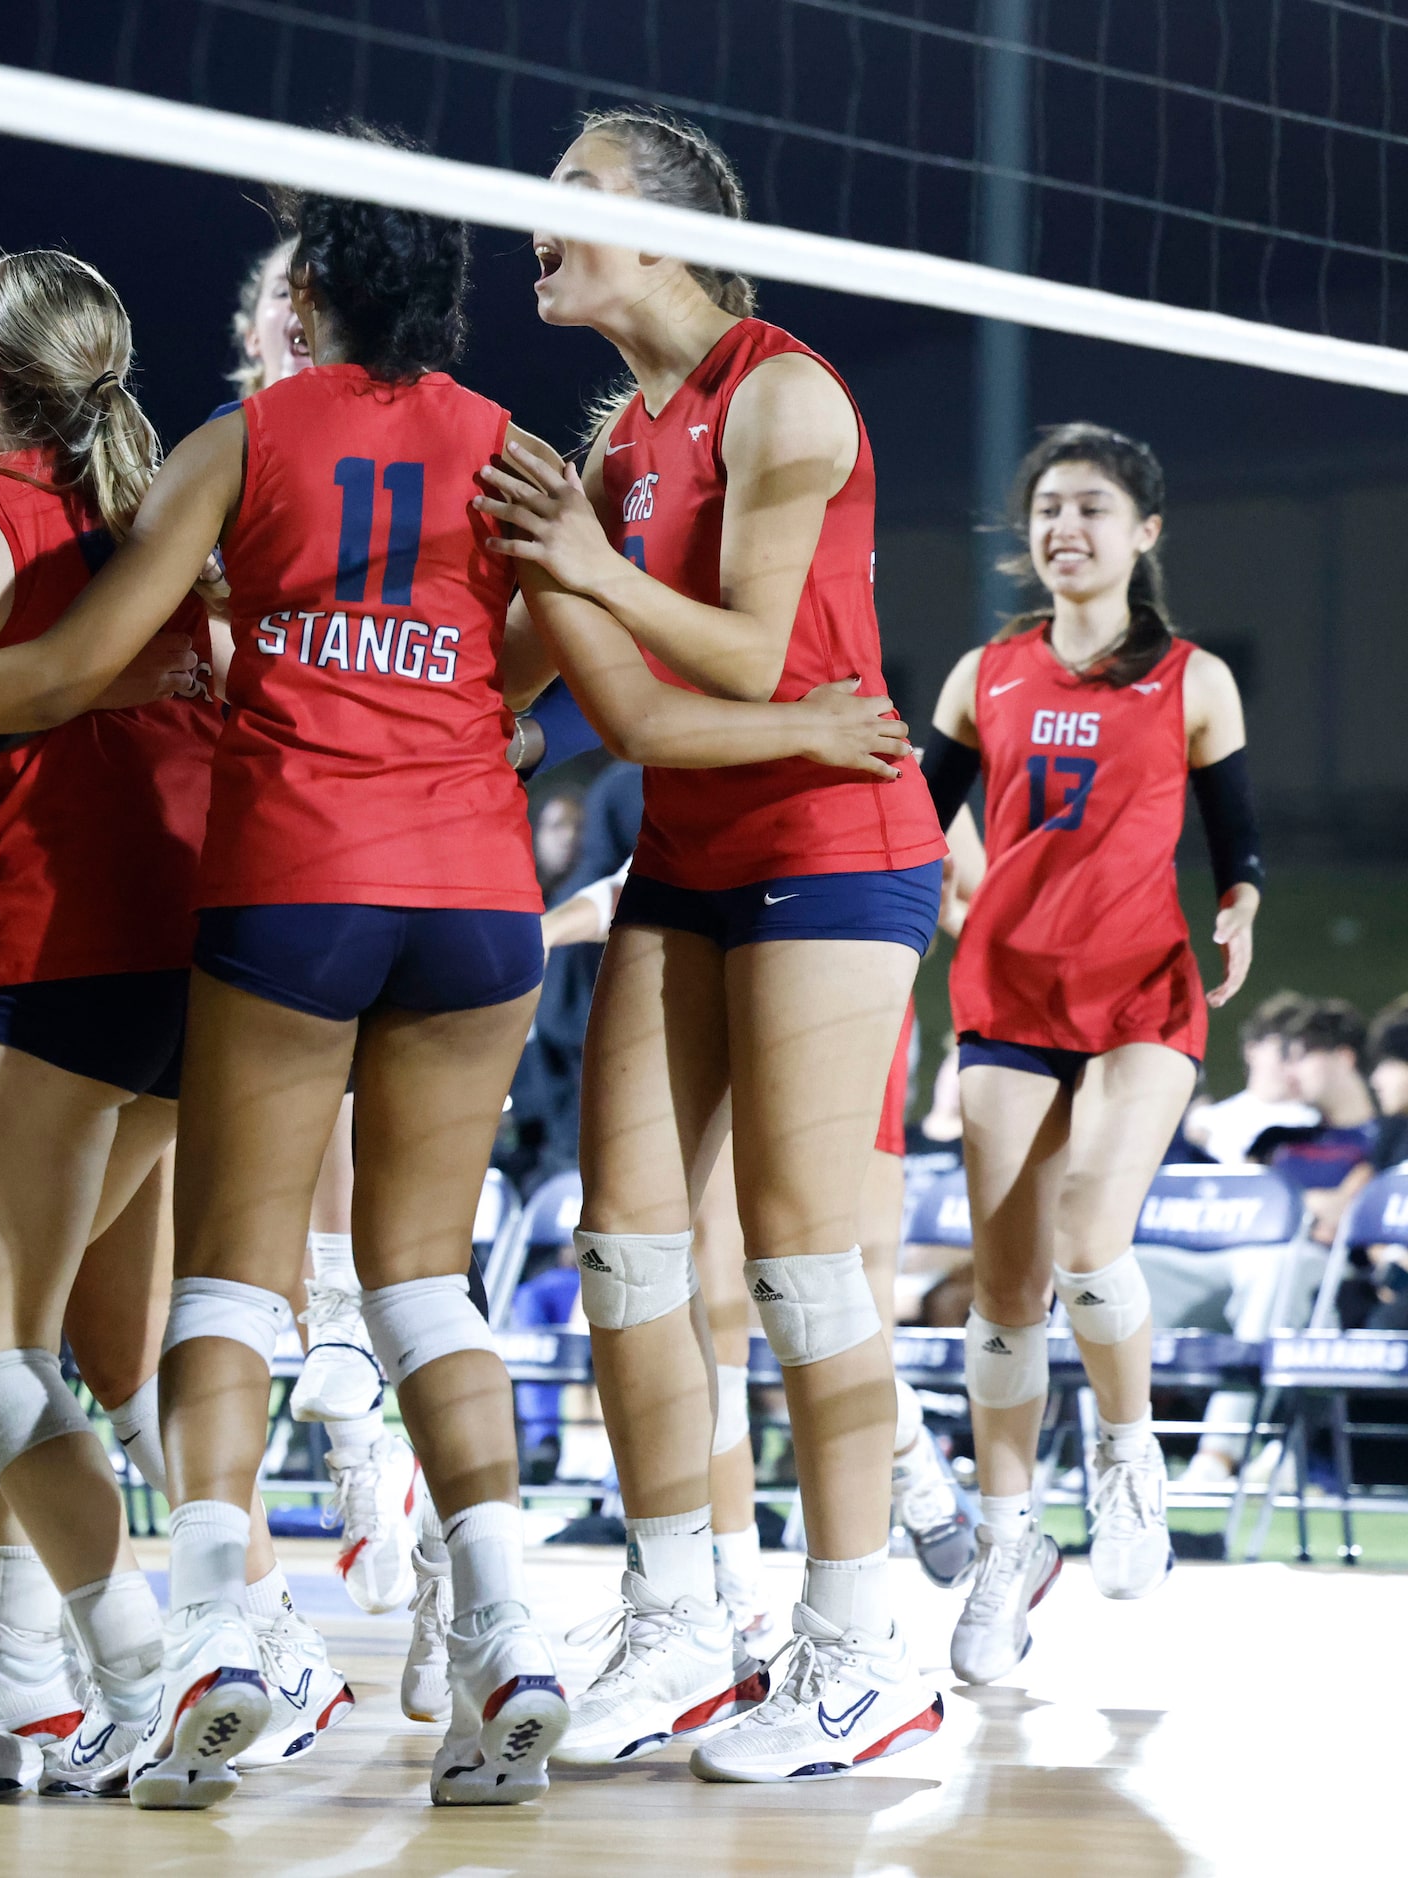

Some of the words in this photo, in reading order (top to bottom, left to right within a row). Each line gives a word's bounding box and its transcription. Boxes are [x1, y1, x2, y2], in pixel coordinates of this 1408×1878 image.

[334, 456, 424, 606] 11
[622, 471, 660, 523] GHS
[257, 610, 460, 683] STANGS
[1030, 708, 1101, 748] GHS
[1026, 754, 1099, 832] 13
